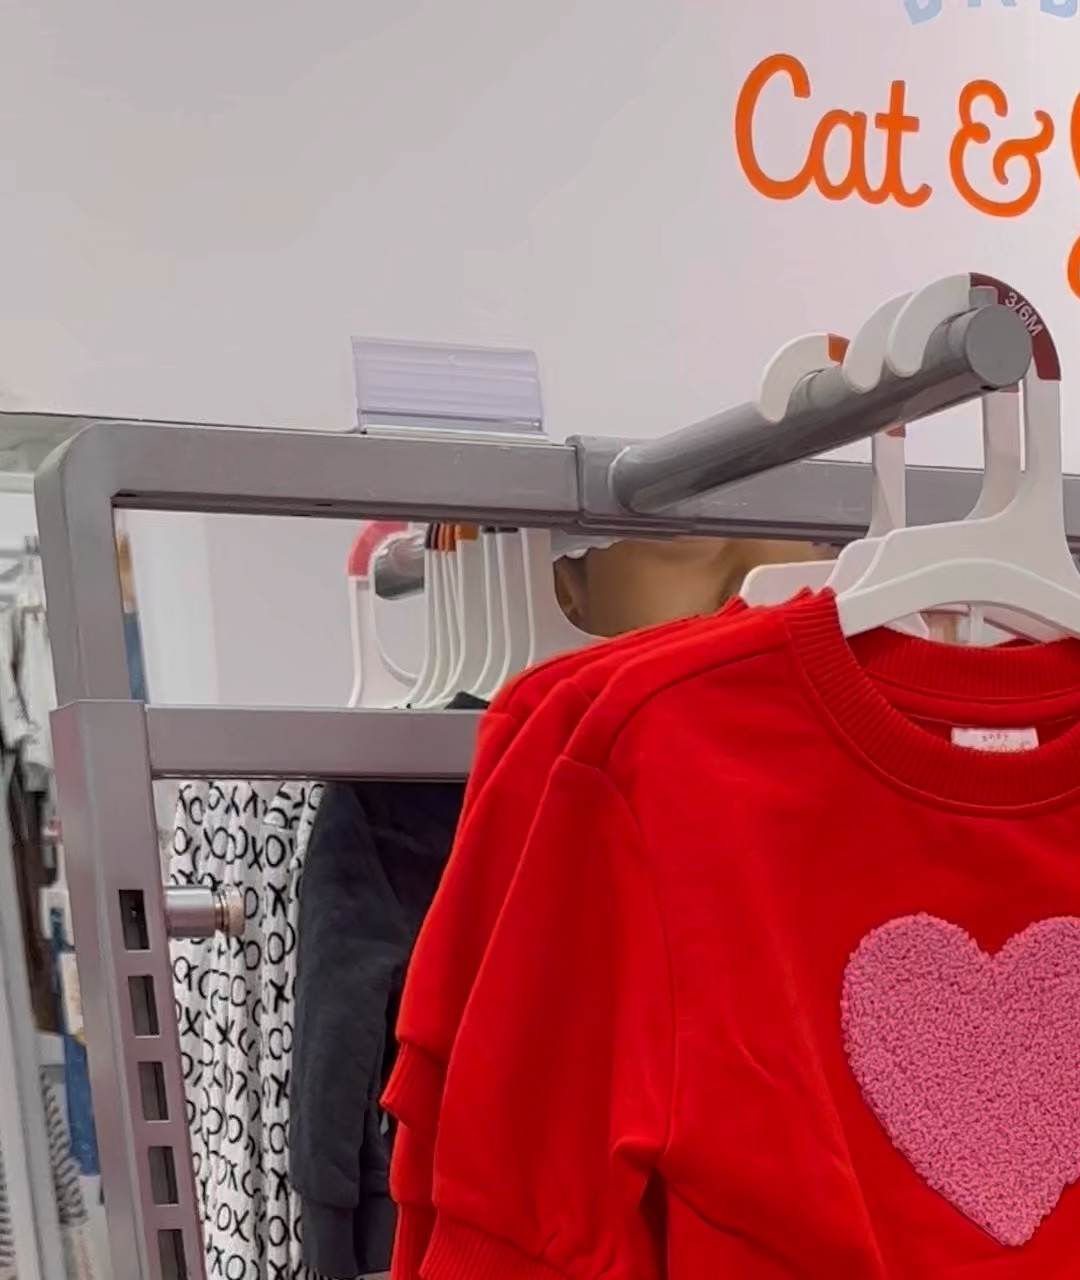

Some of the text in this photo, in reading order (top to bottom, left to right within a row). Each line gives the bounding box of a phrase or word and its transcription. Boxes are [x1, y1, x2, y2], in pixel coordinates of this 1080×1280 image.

[734, 52, 933, 208] Cat
[949, 78, 1055, 218] &
[1005, 291, 1043, 337] 3/6M
